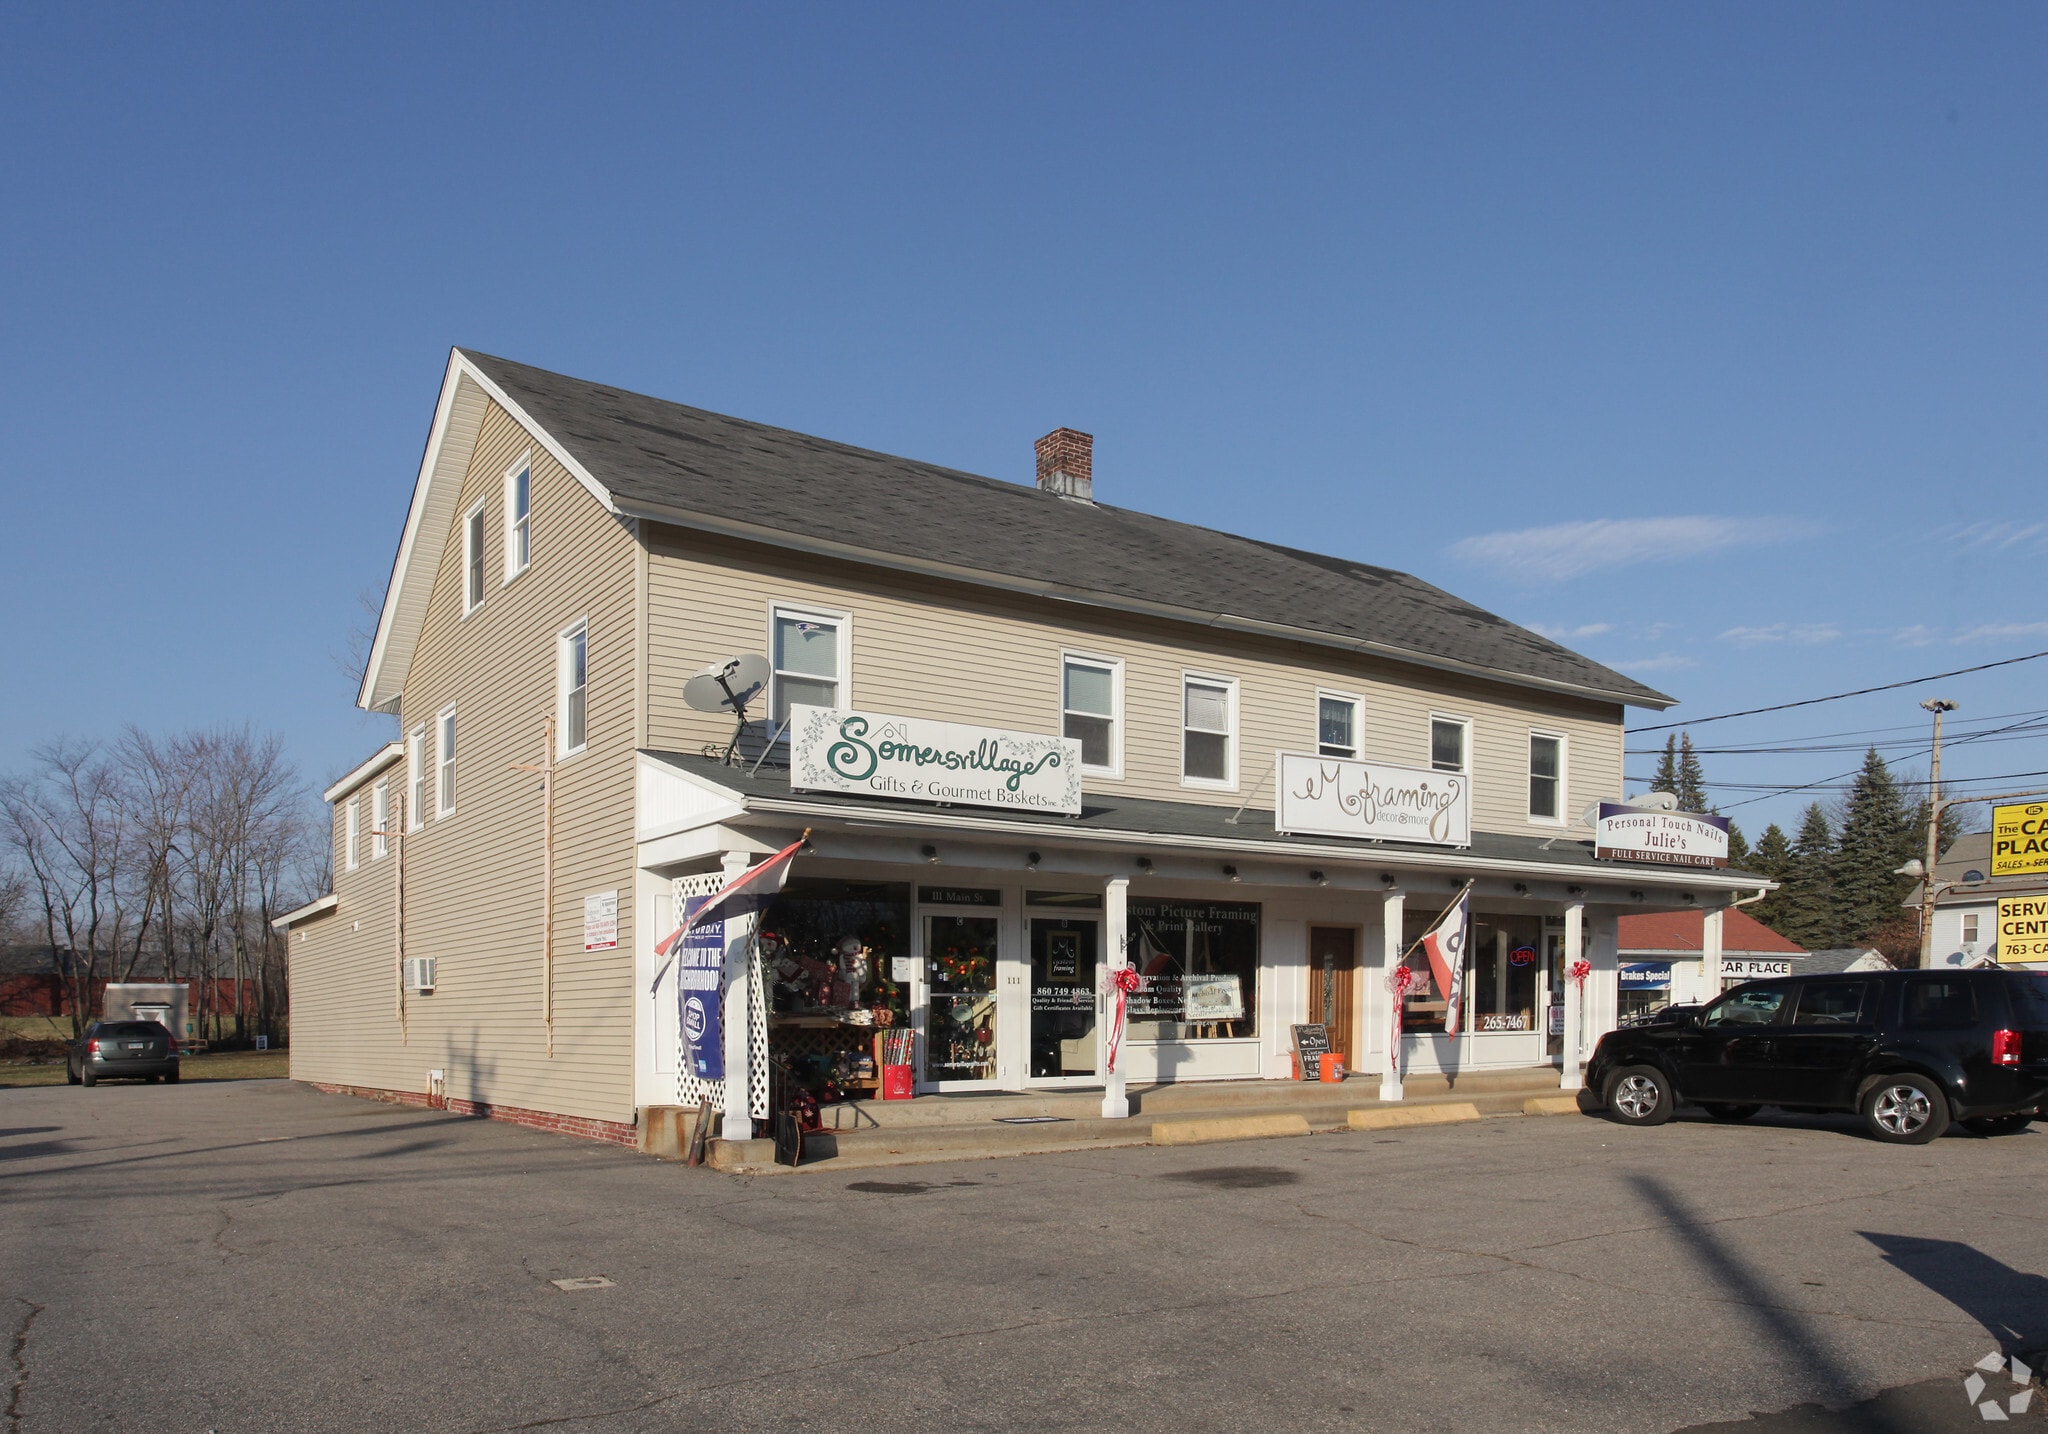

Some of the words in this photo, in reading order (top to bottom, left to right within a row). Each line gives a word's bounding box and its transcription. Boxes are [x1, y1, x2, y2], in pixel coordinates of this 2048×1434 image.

[827, 716, 1060, 791] Somersvillage
[869, 775, 906, 793] Gifts
[911, 779, 924, 793] &
[928, 782, 992, 801] Gourmet
[996, 789, 1047, 807] Baskets
[1359, 771, 1460, 843] framing
[1607, 816, 1656, 832] Personal
[1661, 817, 1692, 832] Touch
[1696, 823, 1722, 843] Nails
[1998, 825, 2018, 835] The
[1644, 831, 1687, 849] Julie's
[1612, 848, 1633, 859] FULL
[1635, 851, 1671, 862] SERVICE
[1673, 854, 1692, 864] NAIL
[1694, 856, 1715, 866] CARE
[1996, 859, 2023, 869] SALES
[946, 892, 970, 901] Main
[1160, 904, 1205, 918] Picture
[1209, 906, 1257, 924] Framing
[2001, 902, 2048, 917] SERV
[1158, 921, 1184, 931] Print
[708, 948, 721, 967] THE
[1510, 950, 1535, 962] OPEN
[1053, 964, 1075, 974] framing
[1749, 962, 1788, 973] PLACE
[1621, 970, 1645, 981] Brakes
[1646, 970, 1670, 983] Special
[1037, 987, 1052, 995] 860
[1054, 987, 1069, 995] 749
[1070, 987, 1090, 996] 4863
[1156, 984, 1183, 994] Quality
[1126, 996, 1152, 1004] Shadow
[1484, 1015, 1529, 1029] 265-7467
[1310, 1037, 1326, 1047] Open
